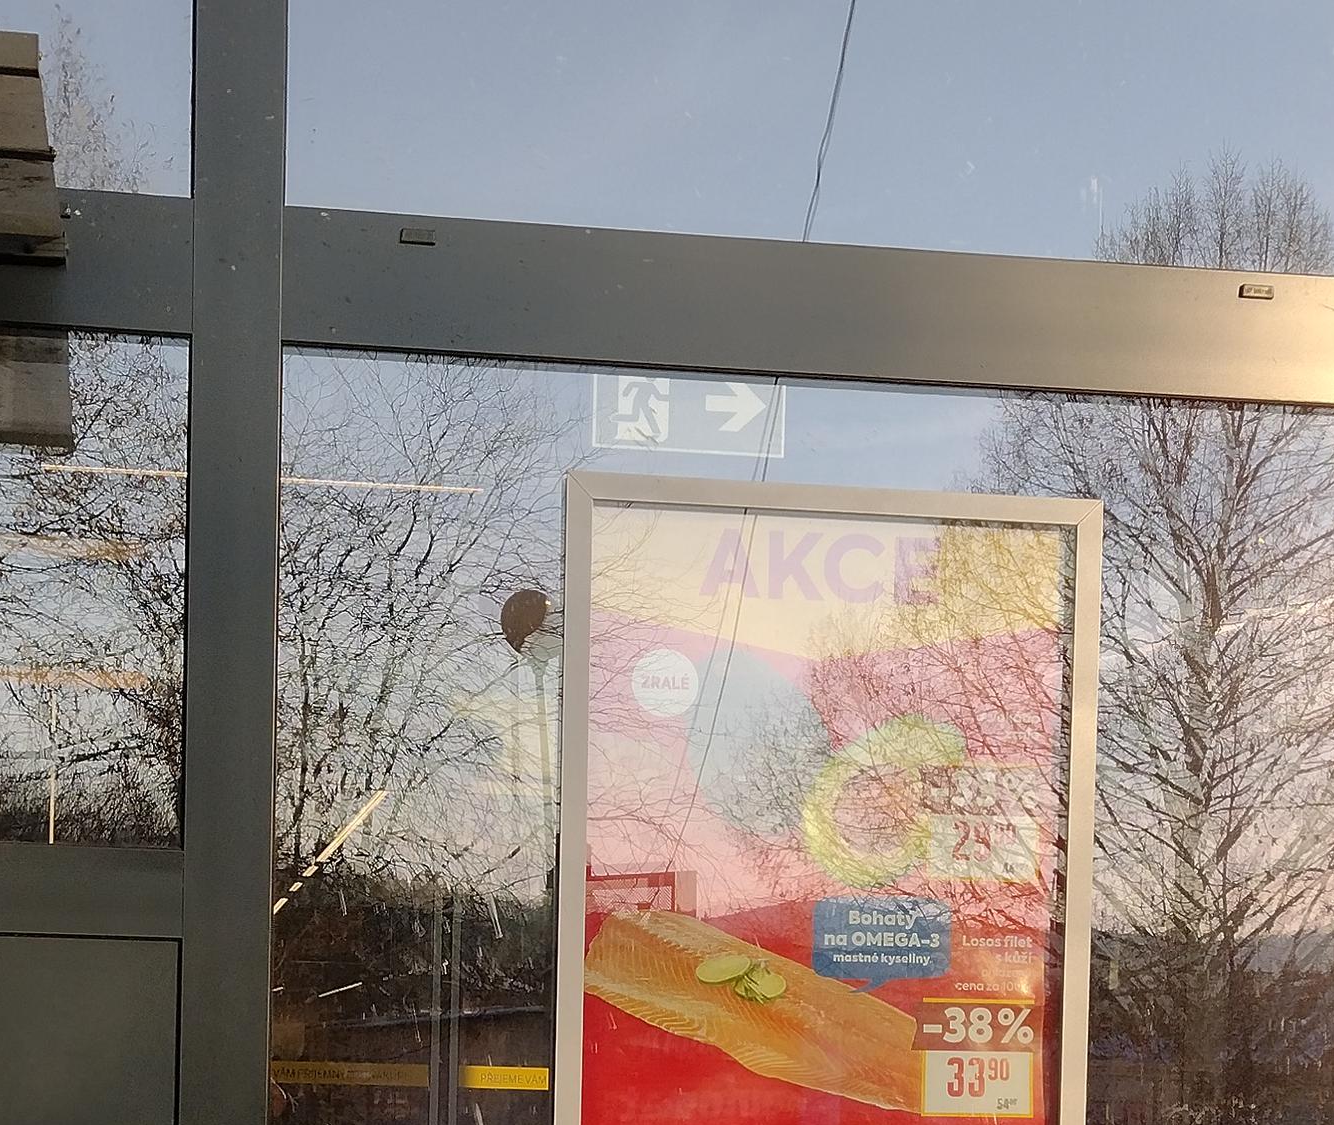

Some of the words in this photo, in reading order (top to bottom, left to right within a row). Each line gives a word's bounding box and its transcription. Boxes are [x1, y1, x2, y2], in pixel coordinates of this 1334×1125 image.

[699, 527, 943, 605] AKCE
[640, 673, 690, 692] ZRALÉ
[849, 908, 917, 930] Bohatý
[824, 934, 847, 946] na
[851, 931, 940, 947] OMEGA-3
[962, 936, 1001, 947] Losos
[1003, 936, 1033, 948] filet
[833, 952, 879, 963] mastné
[955, 982, 984, 991] cena
[986, 983, 1000, 991] za
[923, 1007, 1034, 1044] -38%
[525, 1074, 547, 1084] VÁM
